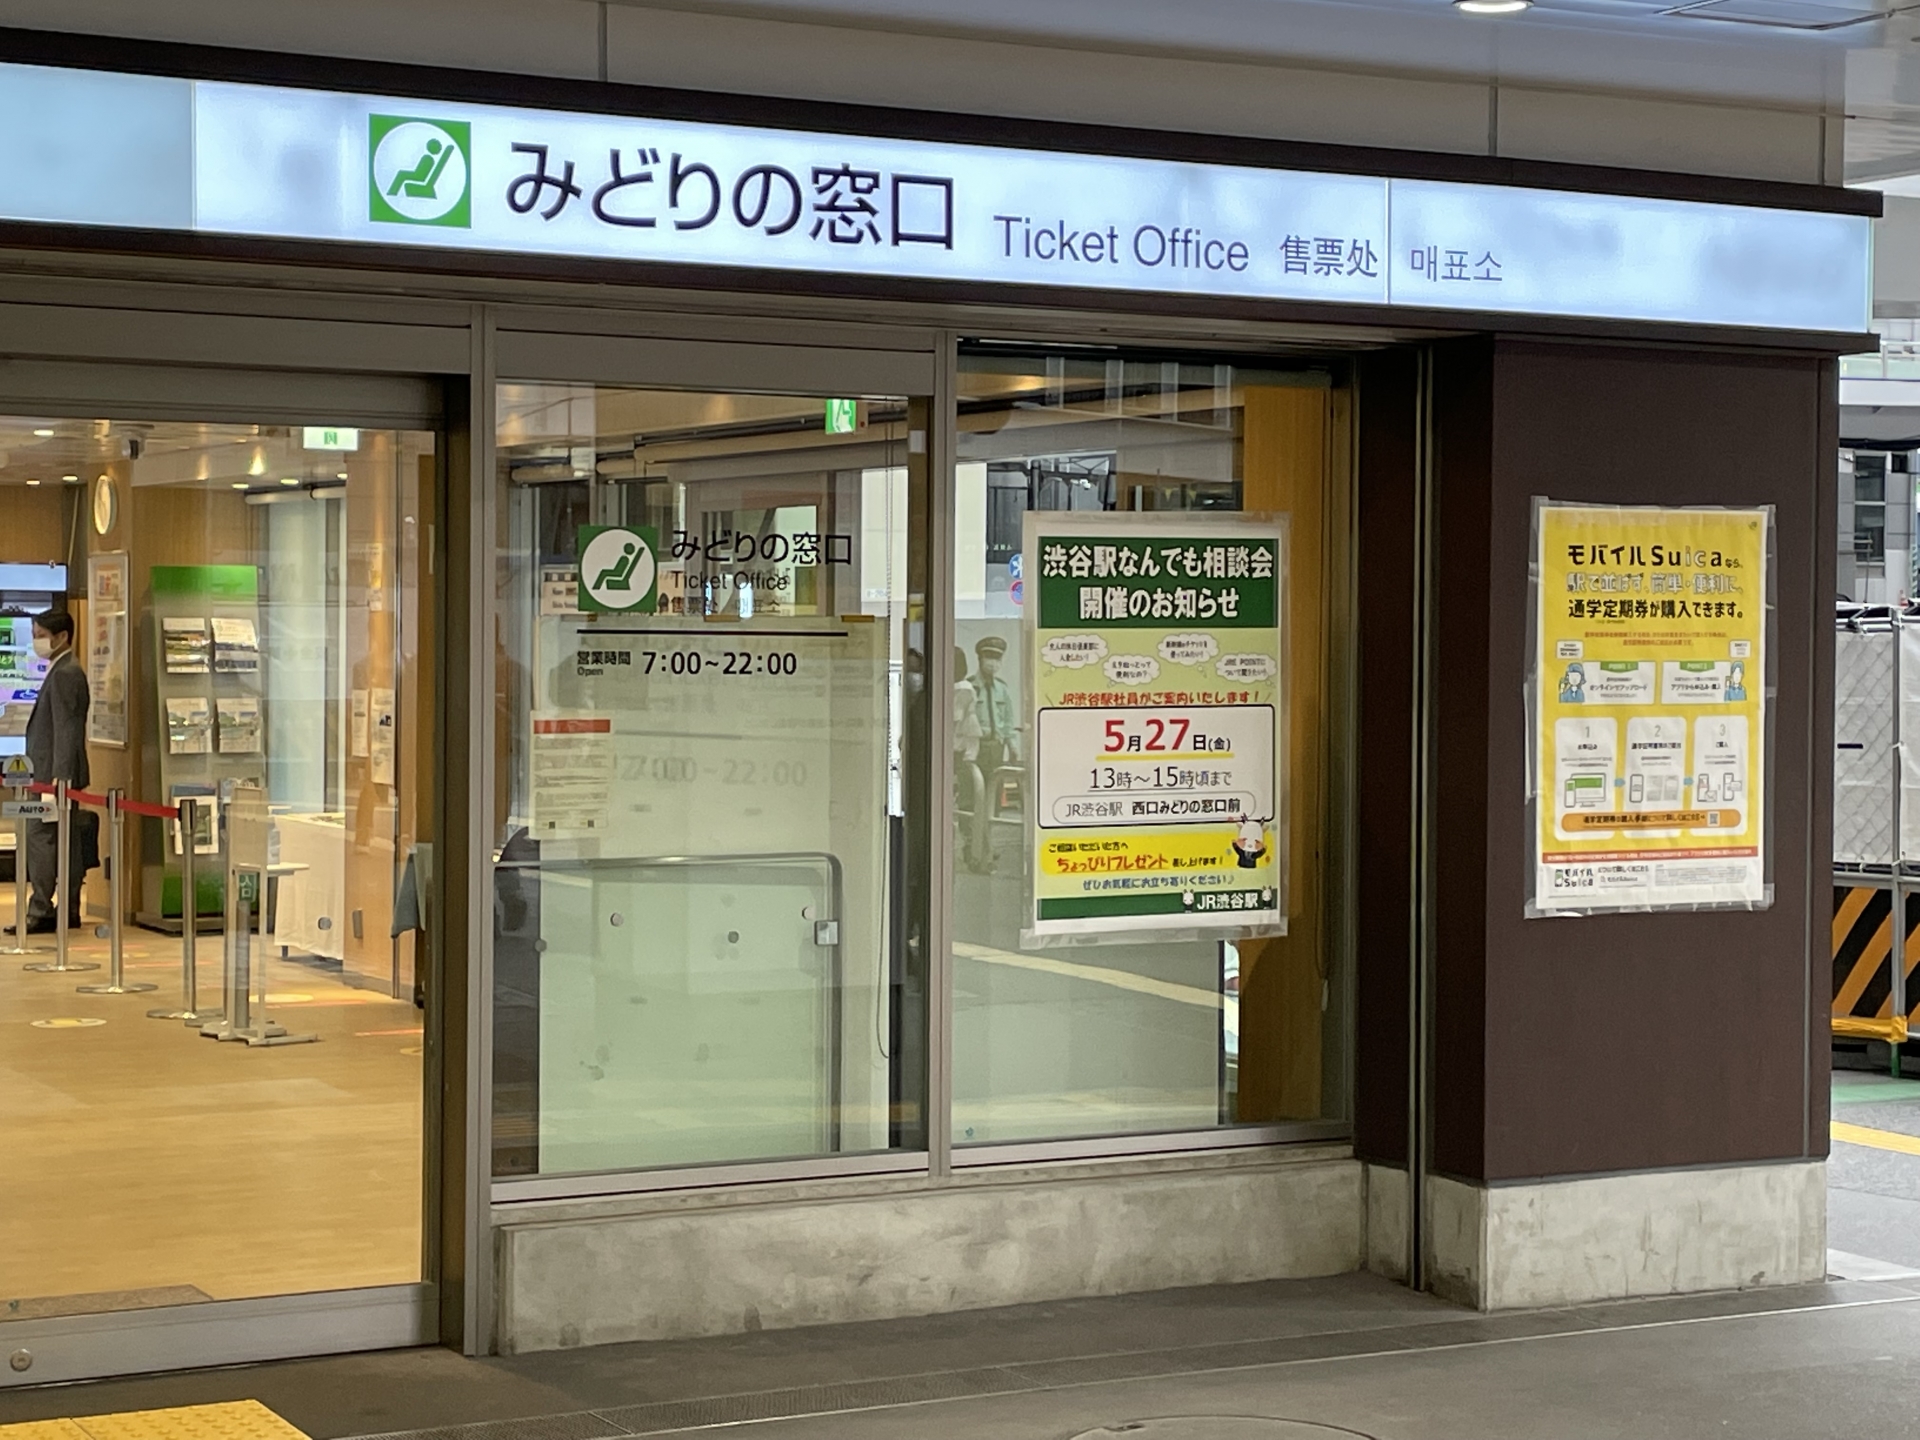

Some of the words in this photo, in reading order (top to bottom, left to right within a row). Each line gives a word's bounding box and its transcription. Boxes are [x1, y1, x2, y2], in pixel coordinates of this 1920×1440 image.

[506, 142, 954, 250] みどりの窓口
[994, 215, 1119, 264] Ticket
[1133, 225, 1249, 272] Office
[1279, 234, 1379, 277] 售票处
[1410, 245, 1503, 282] 매표소
[671, 530, 852, 565] みどりの窓口
[1042, 544, 1274, 578] 渋谷駅なんでも相談会
[671, 571, 727, 589] Ticket
[733, 571, 788, 591] Office
[1079, 587, 1240, 619] 開催のお知らせ
[1568, 599, 1743, 618] 通学定期券が購入できます。
[577, 651, 631, 665] 営業時間
[577, 667, 604, 677] Open
[1104, 719, 1231, 752] 5月27日(金)
[1585, 726, 1590, 738] 1
[1654, 724, 1661, 738] 2
[1719, 723, 1726, 737] 3
[1065, 802, 1123, 818] JR渋谷駅
[1132, 798, 1241, 816] 西口みどりの窓口前
[1196, 892, 1258, 910] JR渋谷駅
